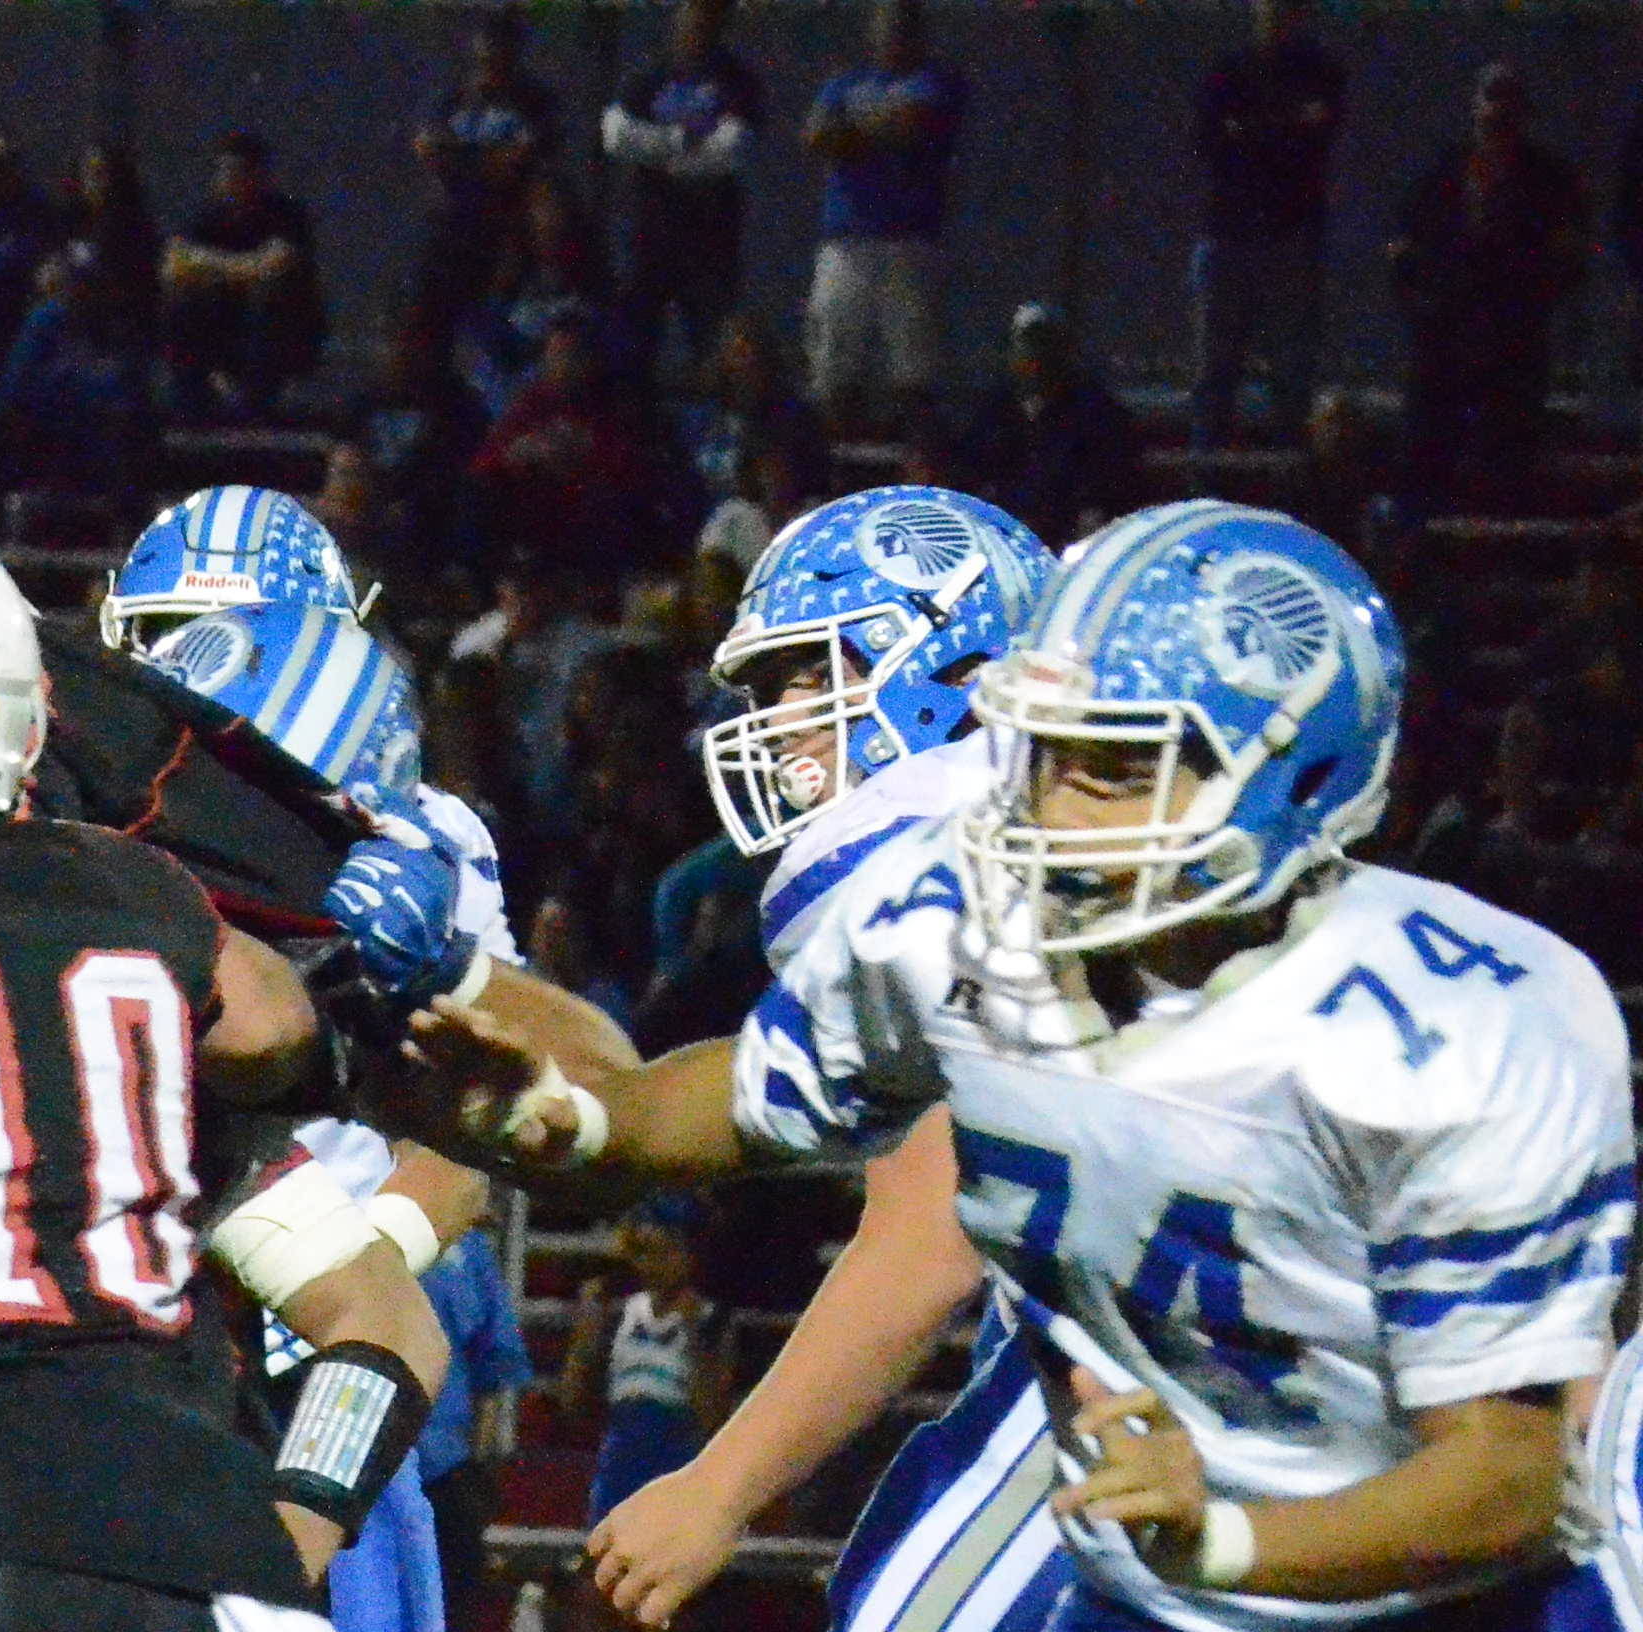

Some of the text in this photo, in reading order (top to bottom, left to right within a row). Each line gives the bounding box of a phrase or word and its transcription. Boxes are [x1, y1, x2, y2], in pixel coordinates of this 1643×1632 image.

[186, 575, 250, 590] Riddell
[1313, 908, 1529, 1070] 74
[951, 1120, 1321, 1426] 74
